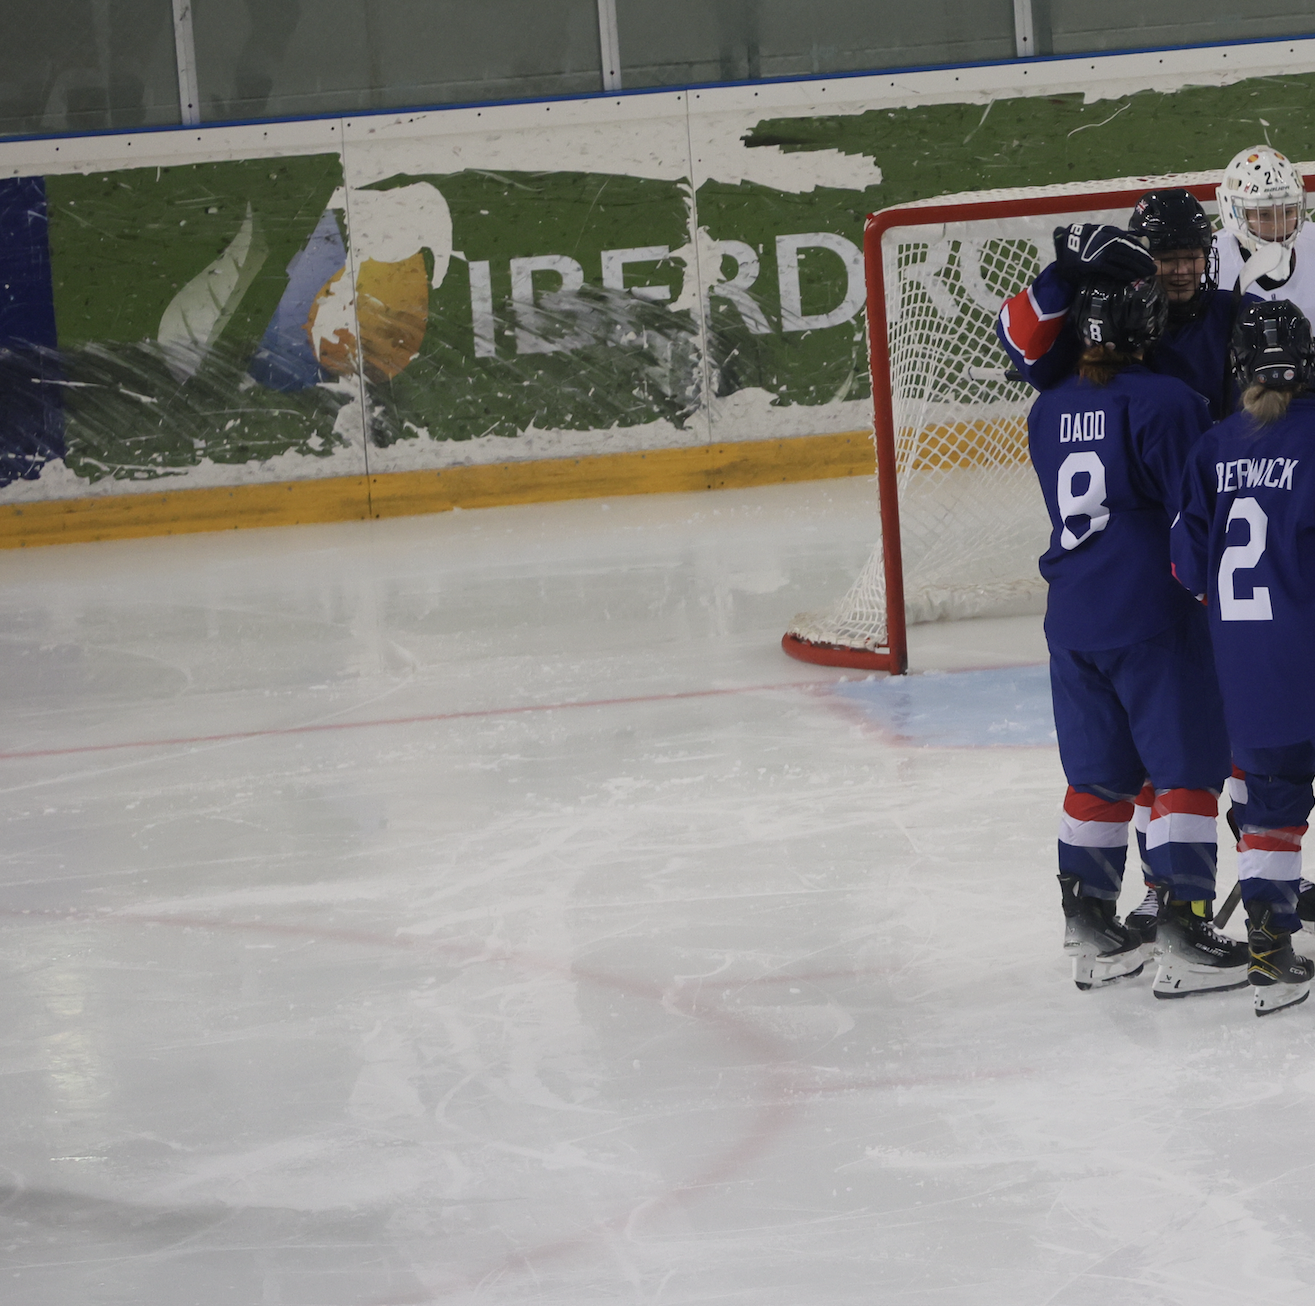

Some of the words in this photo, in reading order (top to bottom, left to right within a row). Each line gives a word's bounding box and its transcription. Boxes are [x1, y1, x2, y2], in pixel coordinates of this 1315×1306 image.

[1060, 410, 1105, 443] DADD
[1057, 450, 1111, 551] 8
[1217, 496, 1274, 621] 2
